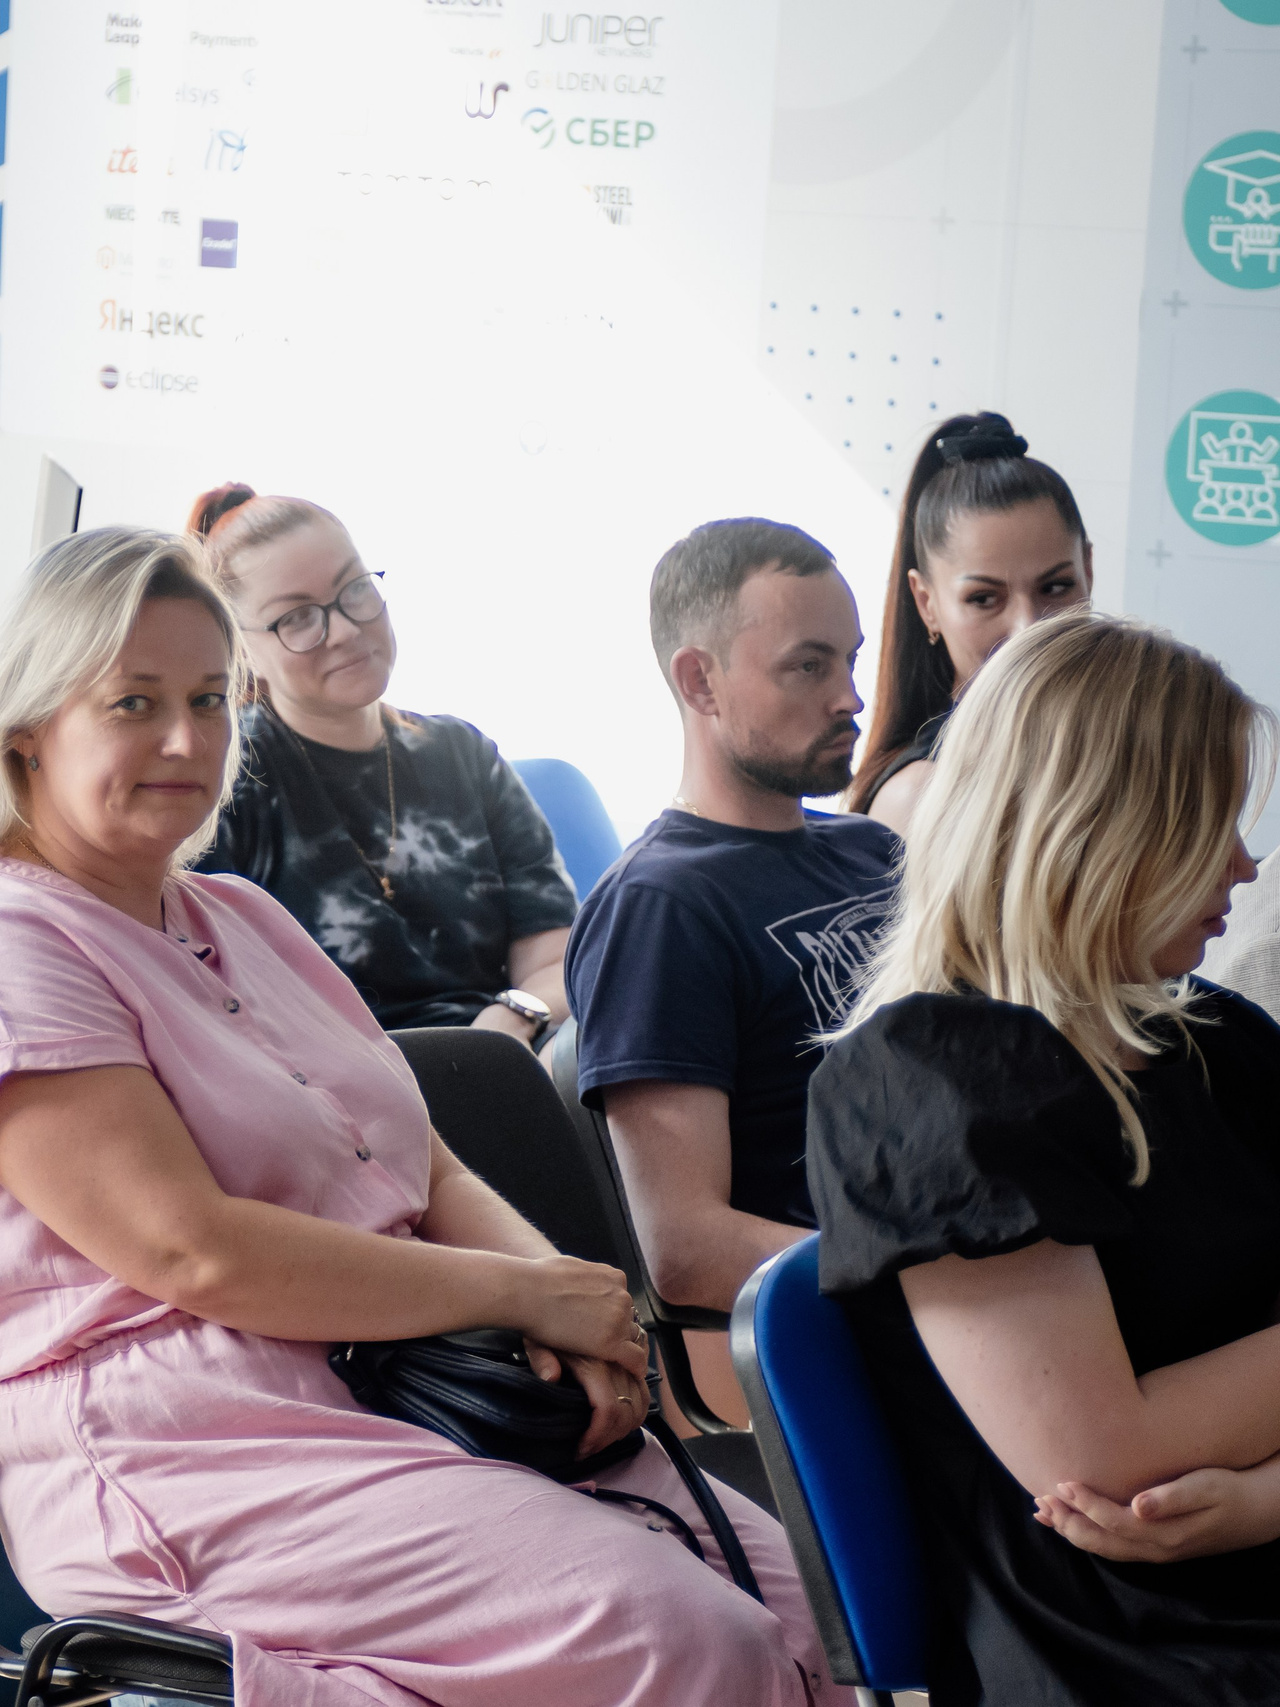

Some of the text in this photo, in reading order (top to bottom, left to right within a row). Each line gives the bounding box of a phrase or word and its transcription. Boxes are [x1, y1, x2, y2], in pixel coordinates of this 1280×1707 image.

[106, 12, 143, 28] Mak
[614, 74, 667, 95] GLAZ
[565, 117, 656, 149] СБЕР
